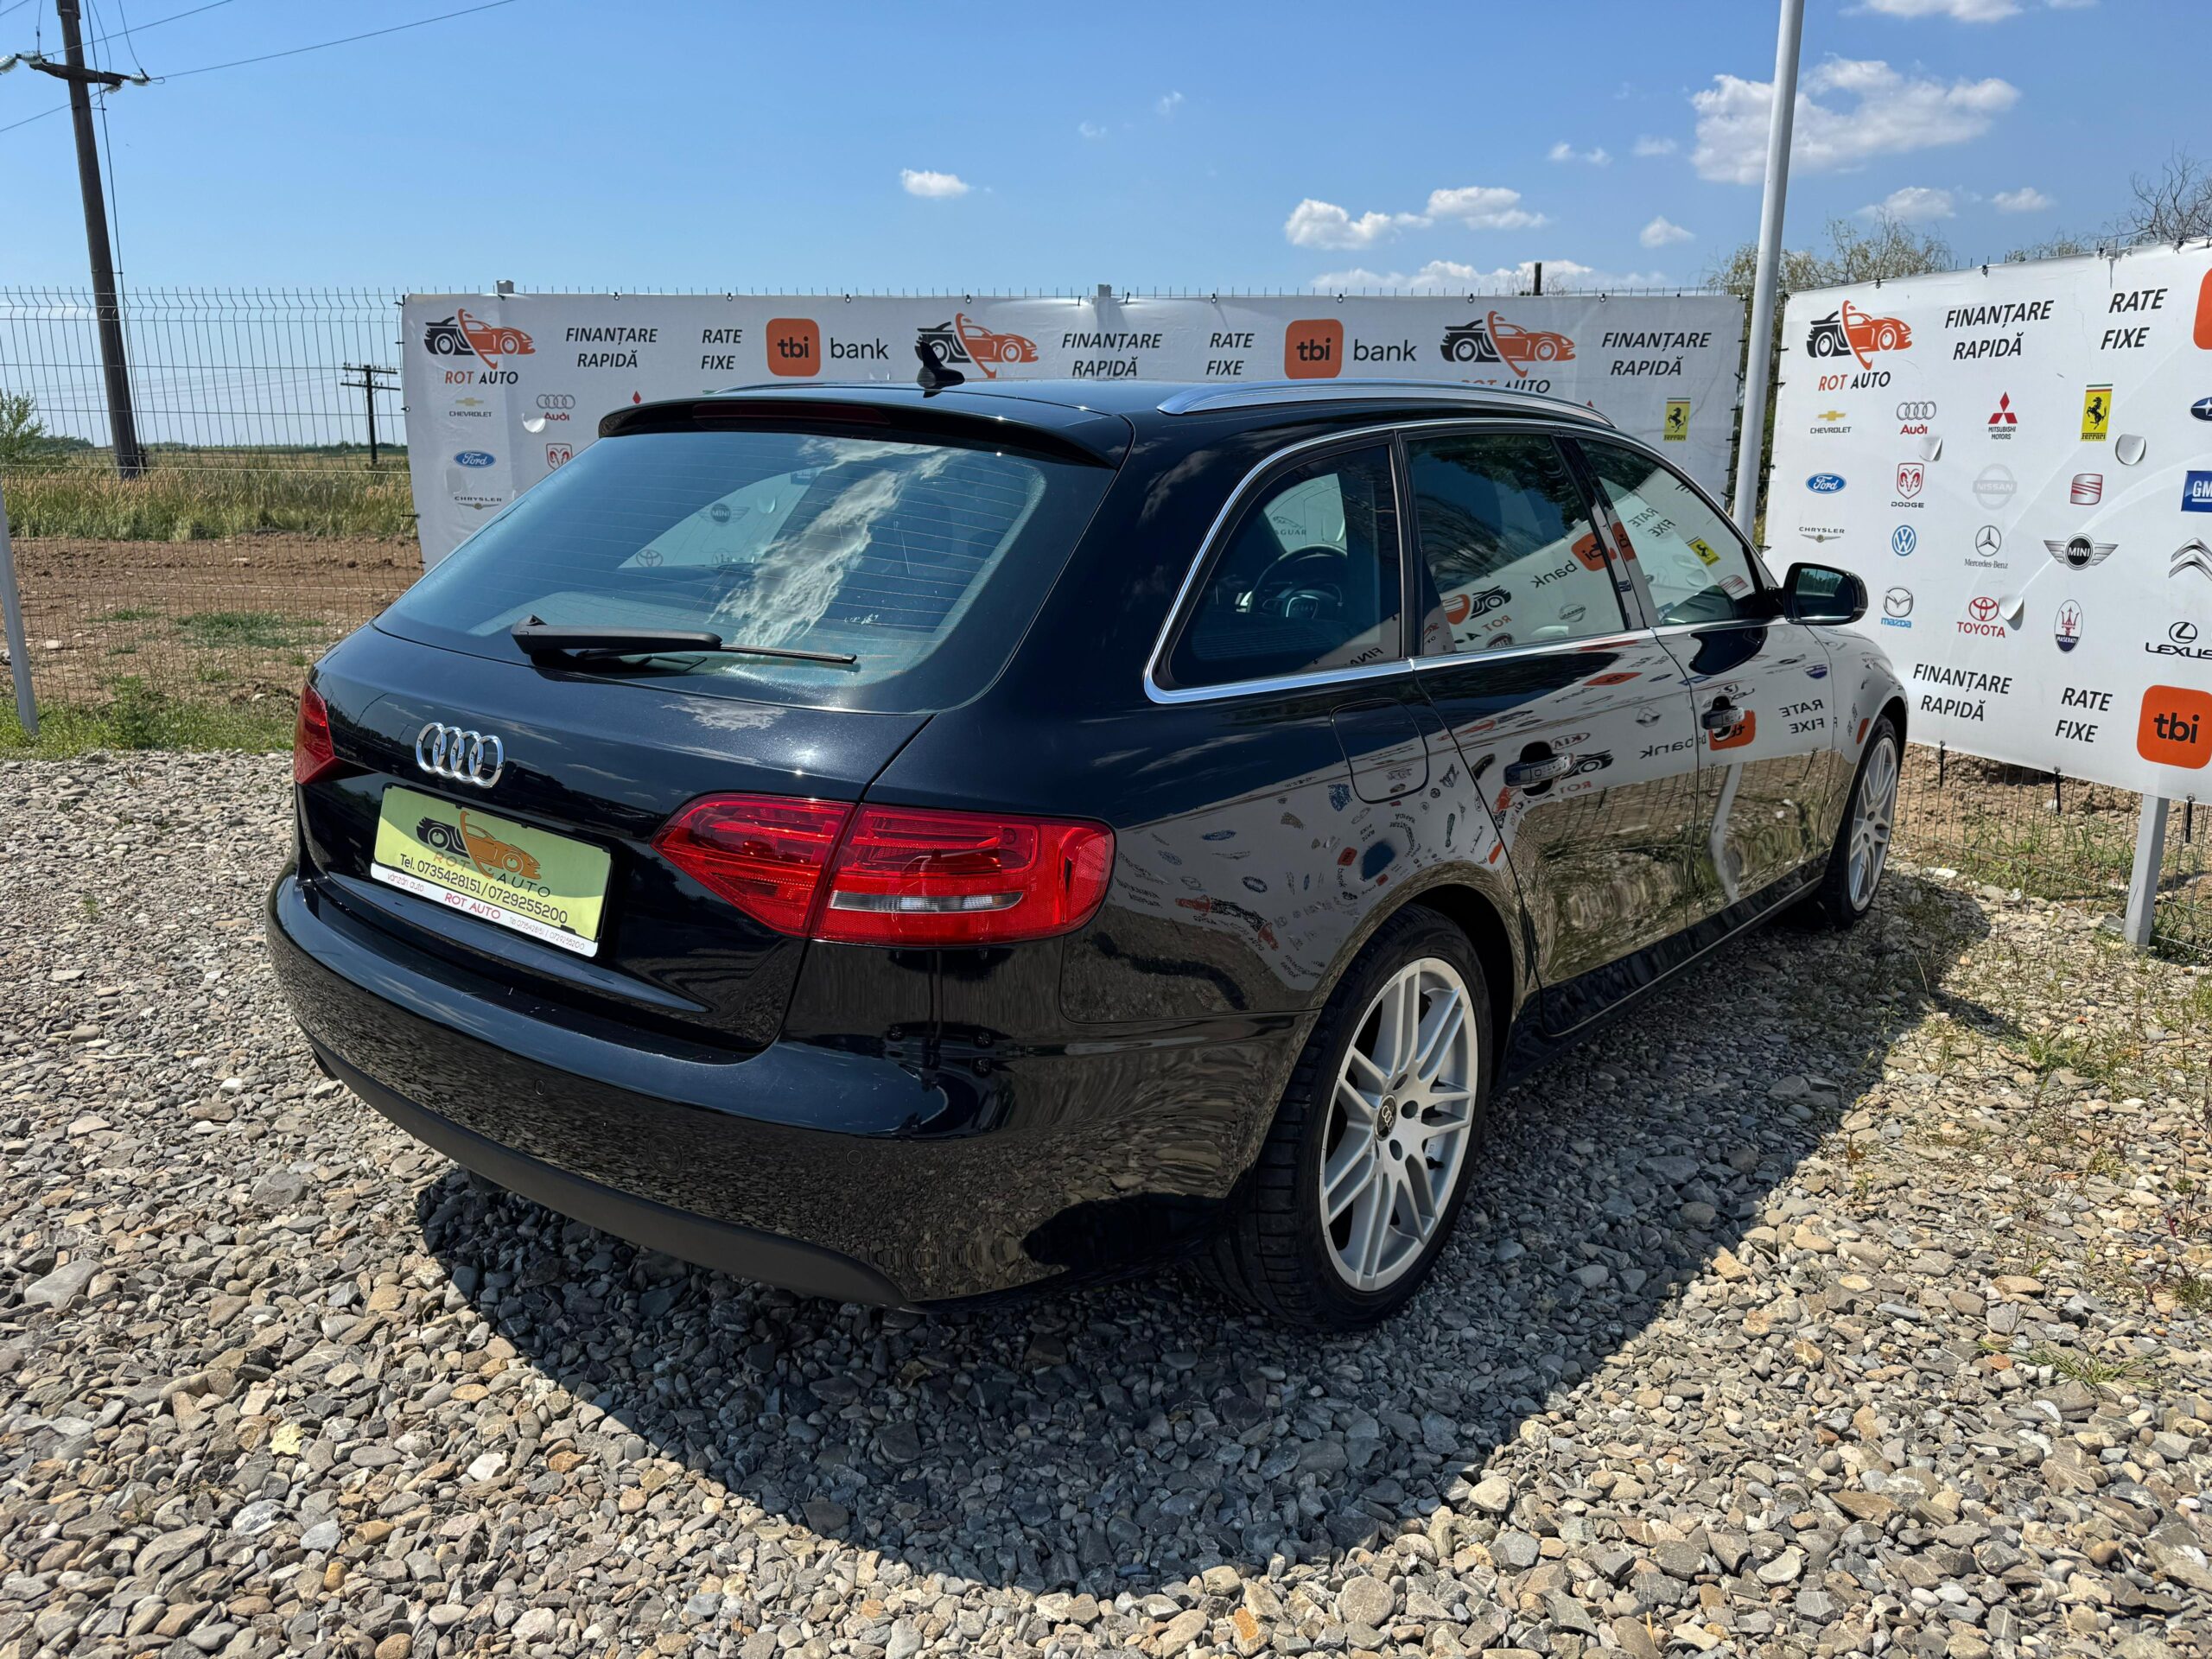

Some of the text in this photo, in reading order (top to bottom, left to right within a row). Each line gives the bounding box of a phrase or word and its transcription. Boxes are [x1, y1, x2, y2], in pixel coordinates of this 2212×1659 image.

[2108, 288, 2168, 314] RATE
[1945, 300, 2055, 328] FINANȚARE
[565, 327, 658, 346] FINANȚARE
[702, 328, 743, 344] RATE
[1062, 333, 1162, 353] FINANȚARE
[1210, 332, 1255, 348] RATE
[1601, 331, 1713, 353] FINANȚARE
[1953, 331, 2024, 360] RAPIDĂ
[2101, 327, 2151, 350] FIXE
[777, 335, 890, 360] tbi bank
[1296, 337, 1418, 362] tbi bank
[577, 349, 639, 369] RAPIDĂ
[701, 354, 736, 371] FIXE
[1072, 355, 1138, 378] RAPIDĂ
[1205, 359, 1245, 376] FIXE
[1610, 355, 1683, 377] RAPIDĂ
[444, 370, 518, 385] ROT AUTO
[1818, 371, 1891, 391] ROT AUTO
[544, 411, 570, 421] Audi
[1809, 426, 1852, 435] CHEVROLET
[1900, 423, 1928, 435] Audi
[461, 453, 488, 465] Ford
[1814, 476, 1839, 490] Ford
[1976, 483, 2013, 492] NISSAN
[2068, 547, 2090, 557] MINI
[1880, 617, 1912, 628] mazda
[1957, 621, 2005, 638] TOYOTA
[1912, 664, 2012, 695] FINANȚARE
[1920, 695, 1986, 721] RAPIDĂ
[2061, 687, 2113, 712] RATE
[2055, 719, 2099, 743] FIXE
[2153, 712, 2200, 745] tbi
[400, 853, 415, 870] Tel.
[433, 851, 551, 898] ROT AUTO
[410, 881, 424, 892] auto
[444, 893, 501, 920] ROT AUTO
